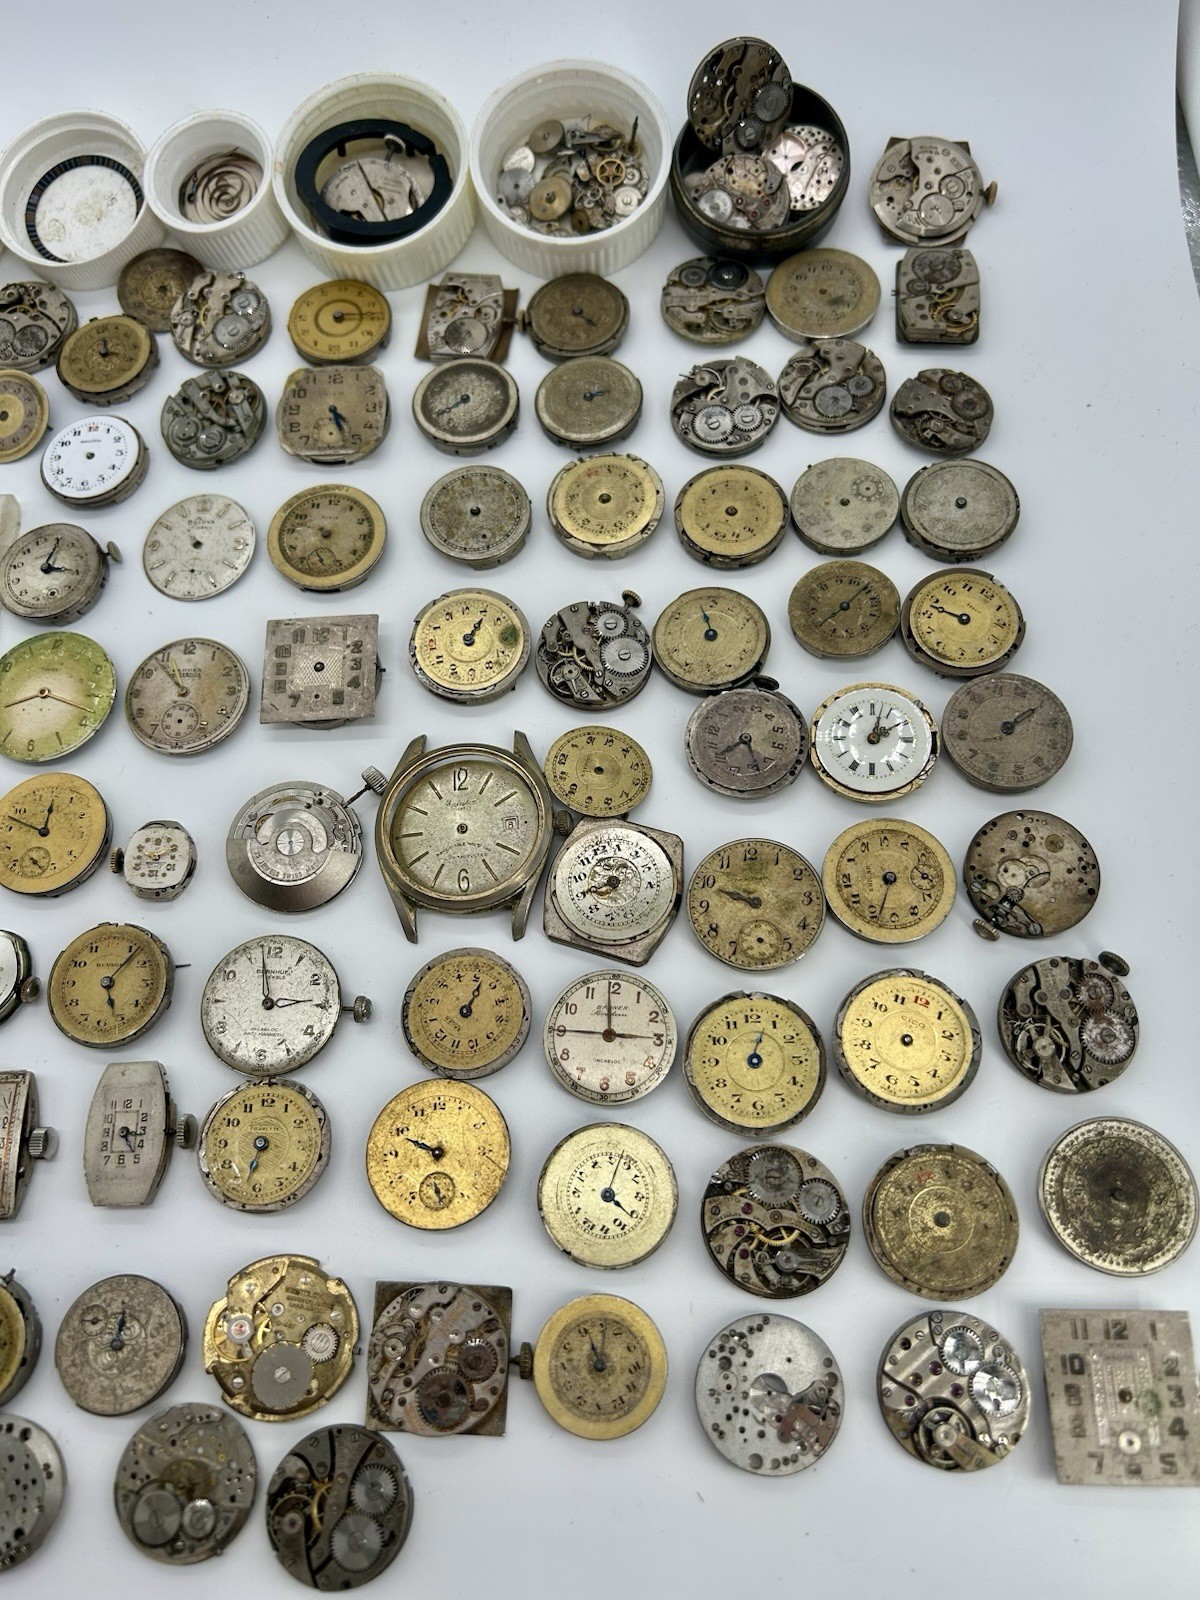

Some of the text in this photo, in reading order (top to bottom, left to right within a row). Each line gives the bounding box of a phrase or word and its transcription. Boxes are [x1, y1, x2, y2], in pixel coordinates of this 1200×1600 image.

[292, 388, 307, 399] 10
[299, 435, 310, 446] 7
[943, 585, 957, 596] 10
[980, 588, 995, 601] 12
[183, 643, 197, 655] 12
[351, 640, 363, 654] 2
[93, 664, 104, 676] 2
[222, 666, 233, 677] 2
[485, 661, 493, 670] 8
[289, 694, 300, 708] 7
[150, 723, 159, 735] 7
[26, 739, 35, 752] 6
[453, 766, 469, 792] 12
[567, 782, 578, 795] 10
[603, 796, 613, 806] 8
[593, 844, 608, 857] 12
[743, 847, 758, 862] 12
[165, 863, 176, 872] 10
[719, 854, 730, 870] 11
[147, 869, 159, 878] 12
[259, 858, 281, 877] JEWELS
[282, 871, 303, 879] SWISS
[792, 867, 804, 881] 2
[457, 868, 470, 894] 6
[572, 871, 587, 883] 10
[700, 874, 716, 889] 10
[842, 873, 852, 889] 12
[801, 891, 813, 907] 3
[851, 893, 860, 905] 11
[699, 899, 710, 916] 9
[867, 904, 878, 920] 10
[909, 905, 919, 916] 8
[796, 915, 809, 931] 4
[707, 922, 719, 939] 8
[89, 945, 99, 953] 11
[728, 940, 738, 956] 7
[780, 937, 792, 952] 5
[266, 946, 284, 959] 12
[72, 960, 87, 968] 10
[136, 960, 147, 968] 2
[222, 969, 237, 981] 10
[310, 972, 322, 986] 2
[66, 980, 77, 988] 9
[139, 979, 150, 988] 3
[585, 986, 596, 1000] 11
[636, 991, 641, 1004] 1
[68, 998, 79, 1007] 8
[130, 999, 140, 1008] 4
[893, 993, 906, 1006] 11
[913, 994, 931, 1009] 12
[564, 1001, 578, 1016] 10
[873, 1001, 889, 1013] 10
[80, 1013, 90, 1021] 7
[96, 1019, 107, 1027] 6
[649, 1010, 660, 1024] 2
[744, 1013, 761, 1024] 12
[861, 1017, 873, 1029] 9
[901, 1014, 926, 1030] CICO
[214, 1020, 227, 1035] 8
[303, 1024, 316, 1036] 4
[556, 1024, 567, 1038] 9
[726, 1020, 738, 1030] 11
[771, 1020, 777, 1030] 1
[652, 1032, 665, 1047] 3
[711, 1036, 727, 1046] 10
[783, 1034, 795, 1044] 2
[941, 1029, 955, 1041] 2
[451, 1039, 461, 1049] 11
[467, 1038, 479, 1050] 10
[859, 1039, 872, 1050] 8
[255, 1048, 267, 1062] 6
[560, 1048, 570, 1061] 8
[791, 1055, 804, 1066] 3
[939, 1049, 952, 1062] 3
[643, 1055, 656, 1070] 4
[707, 1057, 720, 1067] 9
[869, 1057, 882, 1070] 7
[576, 1066, 586, 1081] 7
[624, 1071, 636, 1086] 5
[926, 1068, 939, 1079] 4
[599, 1076, 611, 1092] 6
[715, 1077, 727, 1088] 8
[787, 1076, 799, 1086] 4
[885, 1074, 899, 1086] 6
[907, 1075, 920, 1087] 5
[260, 1097, 276, 1108] 12
[731, 1093, 743, 1103] 7
[773, 1092, 785, 1103] 5
[110, 1100, 118, 1110] 11
[122, 1099, 133, 1109] 12
[243, 1103, 253, 1113] 11
[432, 1101, 447, 1111] 12
[752, 1099, 765, 1111] 6
[141, 1112, 149, 1122] 2
[414, 1108, 425, 1117] 11
[225, 1117, 241, 1128] 10
[293, 1118, 304, 1129] 2
[139, 1125, 147, 1136] 3
[100, 1141, 109, 1152] 8
[137, 1139, 145, 1149] 4
[217, 1139, 228, 1149] 9
[103, 1155, 111, 1165] 7
[117, 1154, 126, 1165] 6
[133, 1154, 141, 1164] 5
[220, 1159, 233, 1170] 8
[287, 1161, 299, 1172] 4
[274, 1176, 284, 1187] 5
[631, 1173, 640, 1185] 7
[251, 1182, 262, 1193] 6
[571, 1187, 582, 1199] 2
[634, 1191, 645, 1202] 8
[582, 1217, 597, 1231] 12
[599, 1224, 610, 1235] 11
[612, 1218, 628, 1232] 10
[1069, 1318, 1089, 1340] 11
[1102, 1318, 1129, 1340] 12
[1149, 1319, 1158, 1340] 1
[628, 1360, 641, 1375] 10
[1059, 1353, 1086, 1375] 10
[1162, 1357, 1181, 1377] 2
[1063, 1383, 1082, 1407] 9
[1166, 1384, 1186, 1408] 3
[1167, 1416, 1189, 1441] 4
[1087, 1452, 1105, 1475] 7
[1159, 1452, 1178, 1475] 5
